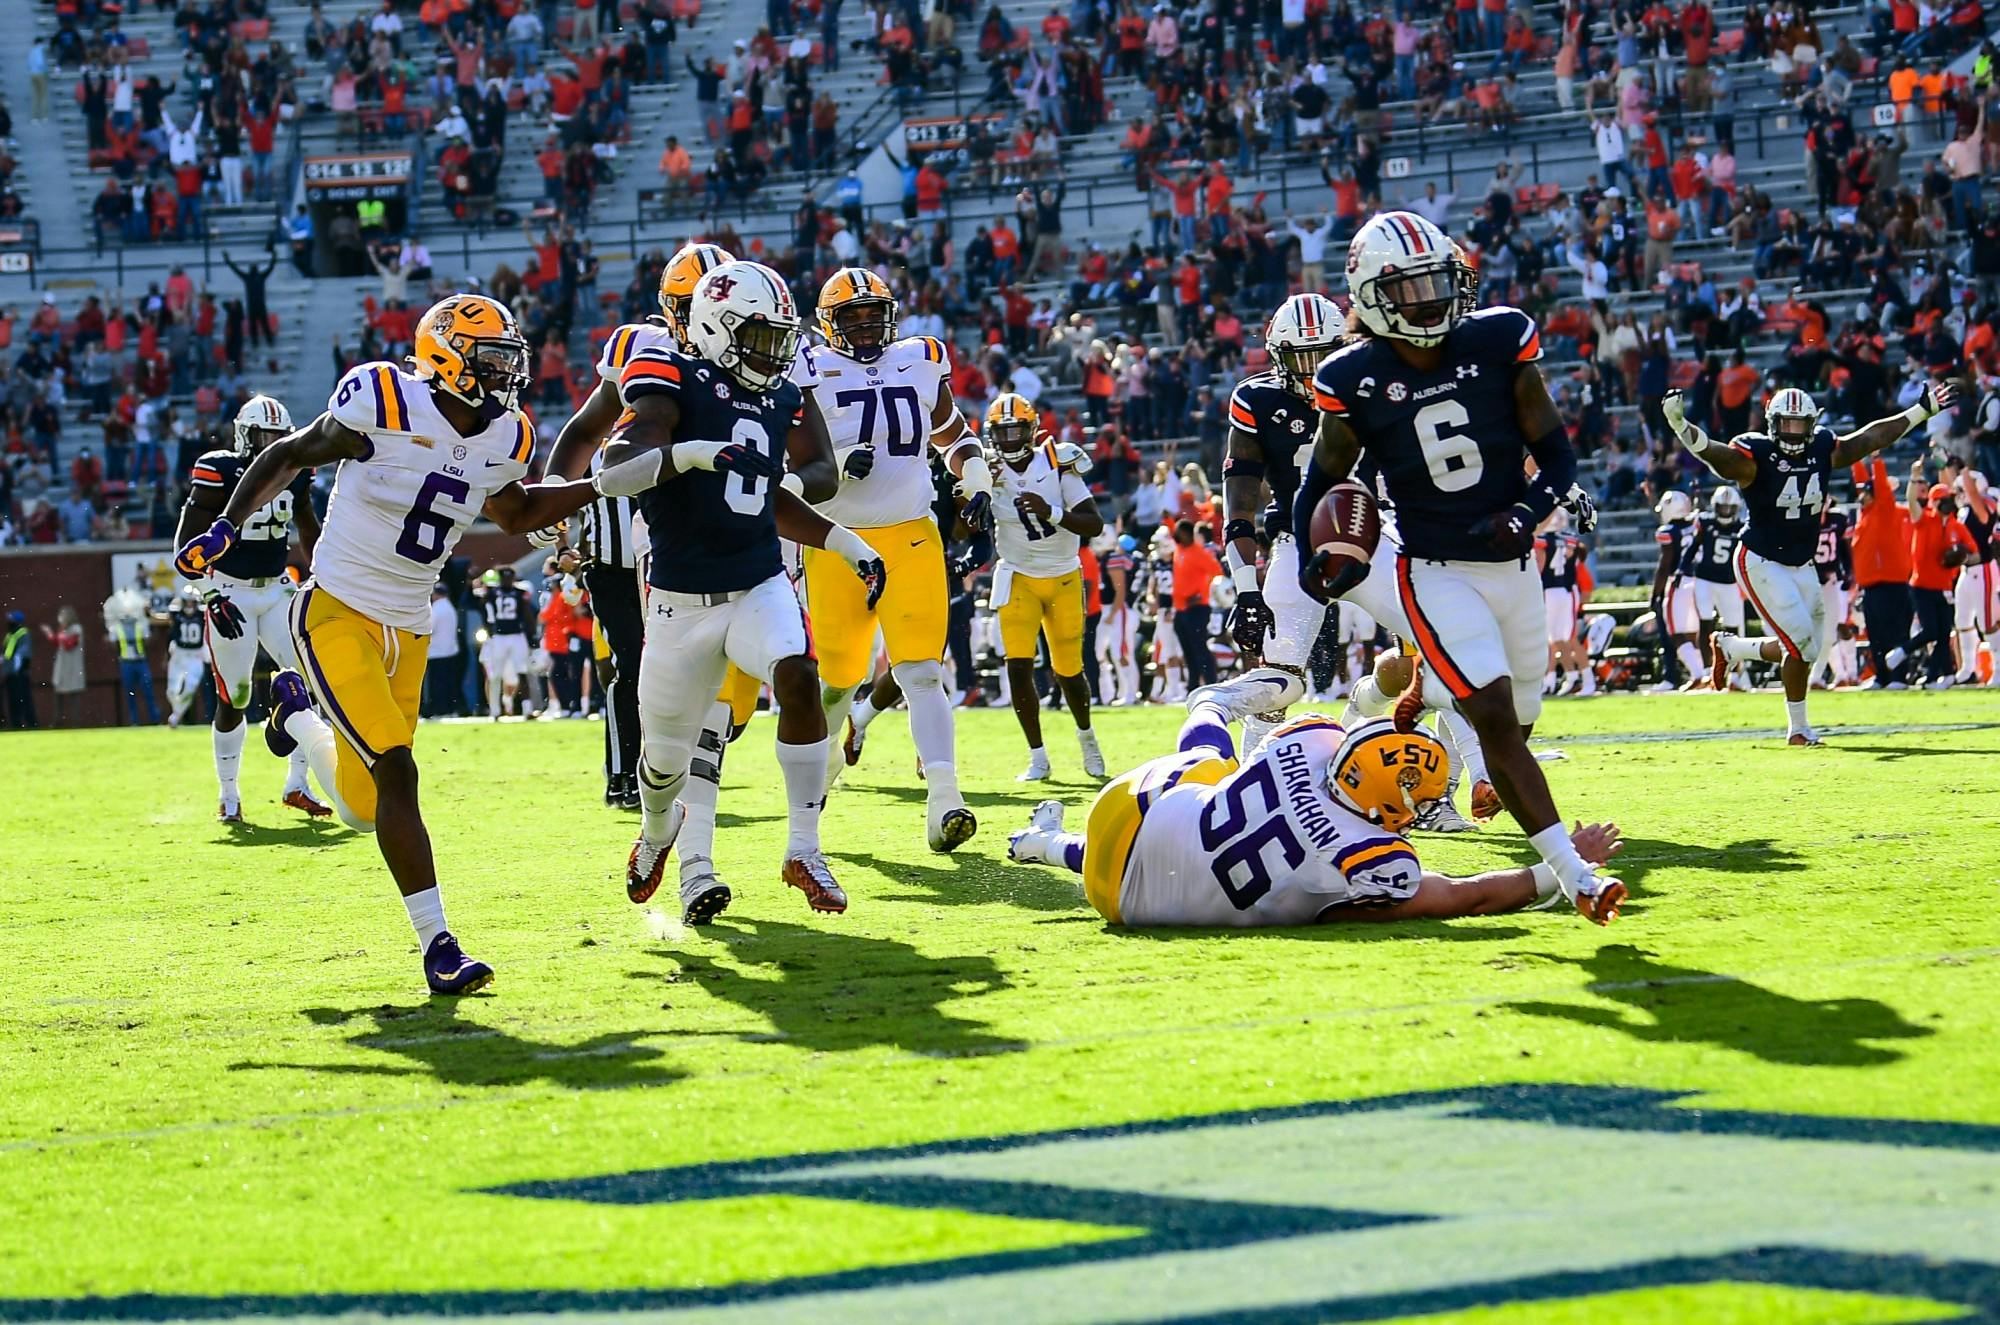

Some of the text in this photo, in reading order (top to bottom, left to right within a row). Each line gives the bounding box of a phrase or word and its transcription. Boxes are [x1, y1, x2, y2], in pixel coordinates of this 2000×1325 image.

[337, 376, 362, 408] 6
[866, 379, 885, 387] LSU
[1412, 381, 1458, 401] AUBURN
[835, 386, 923, 457] 70
[1413, 399, 1484, 493] 6
[442, 463, 464, 477] LSU
[1776, 472, 1823, 519] 44
[241, 489, 295, 540] 29
[395, 471, 470, 564] 6
[1712, 538, 1732, 564] 5
[1814, 531, 1837, 564] 51
[495, 597, 518, 620] 12
[180, 622, 200, 643] 10
[1379, 743, 1440, 774] LSU
[1276, 742, 1341, 849] SHANAHAN
[1200, 758, 1306, 912] 56
